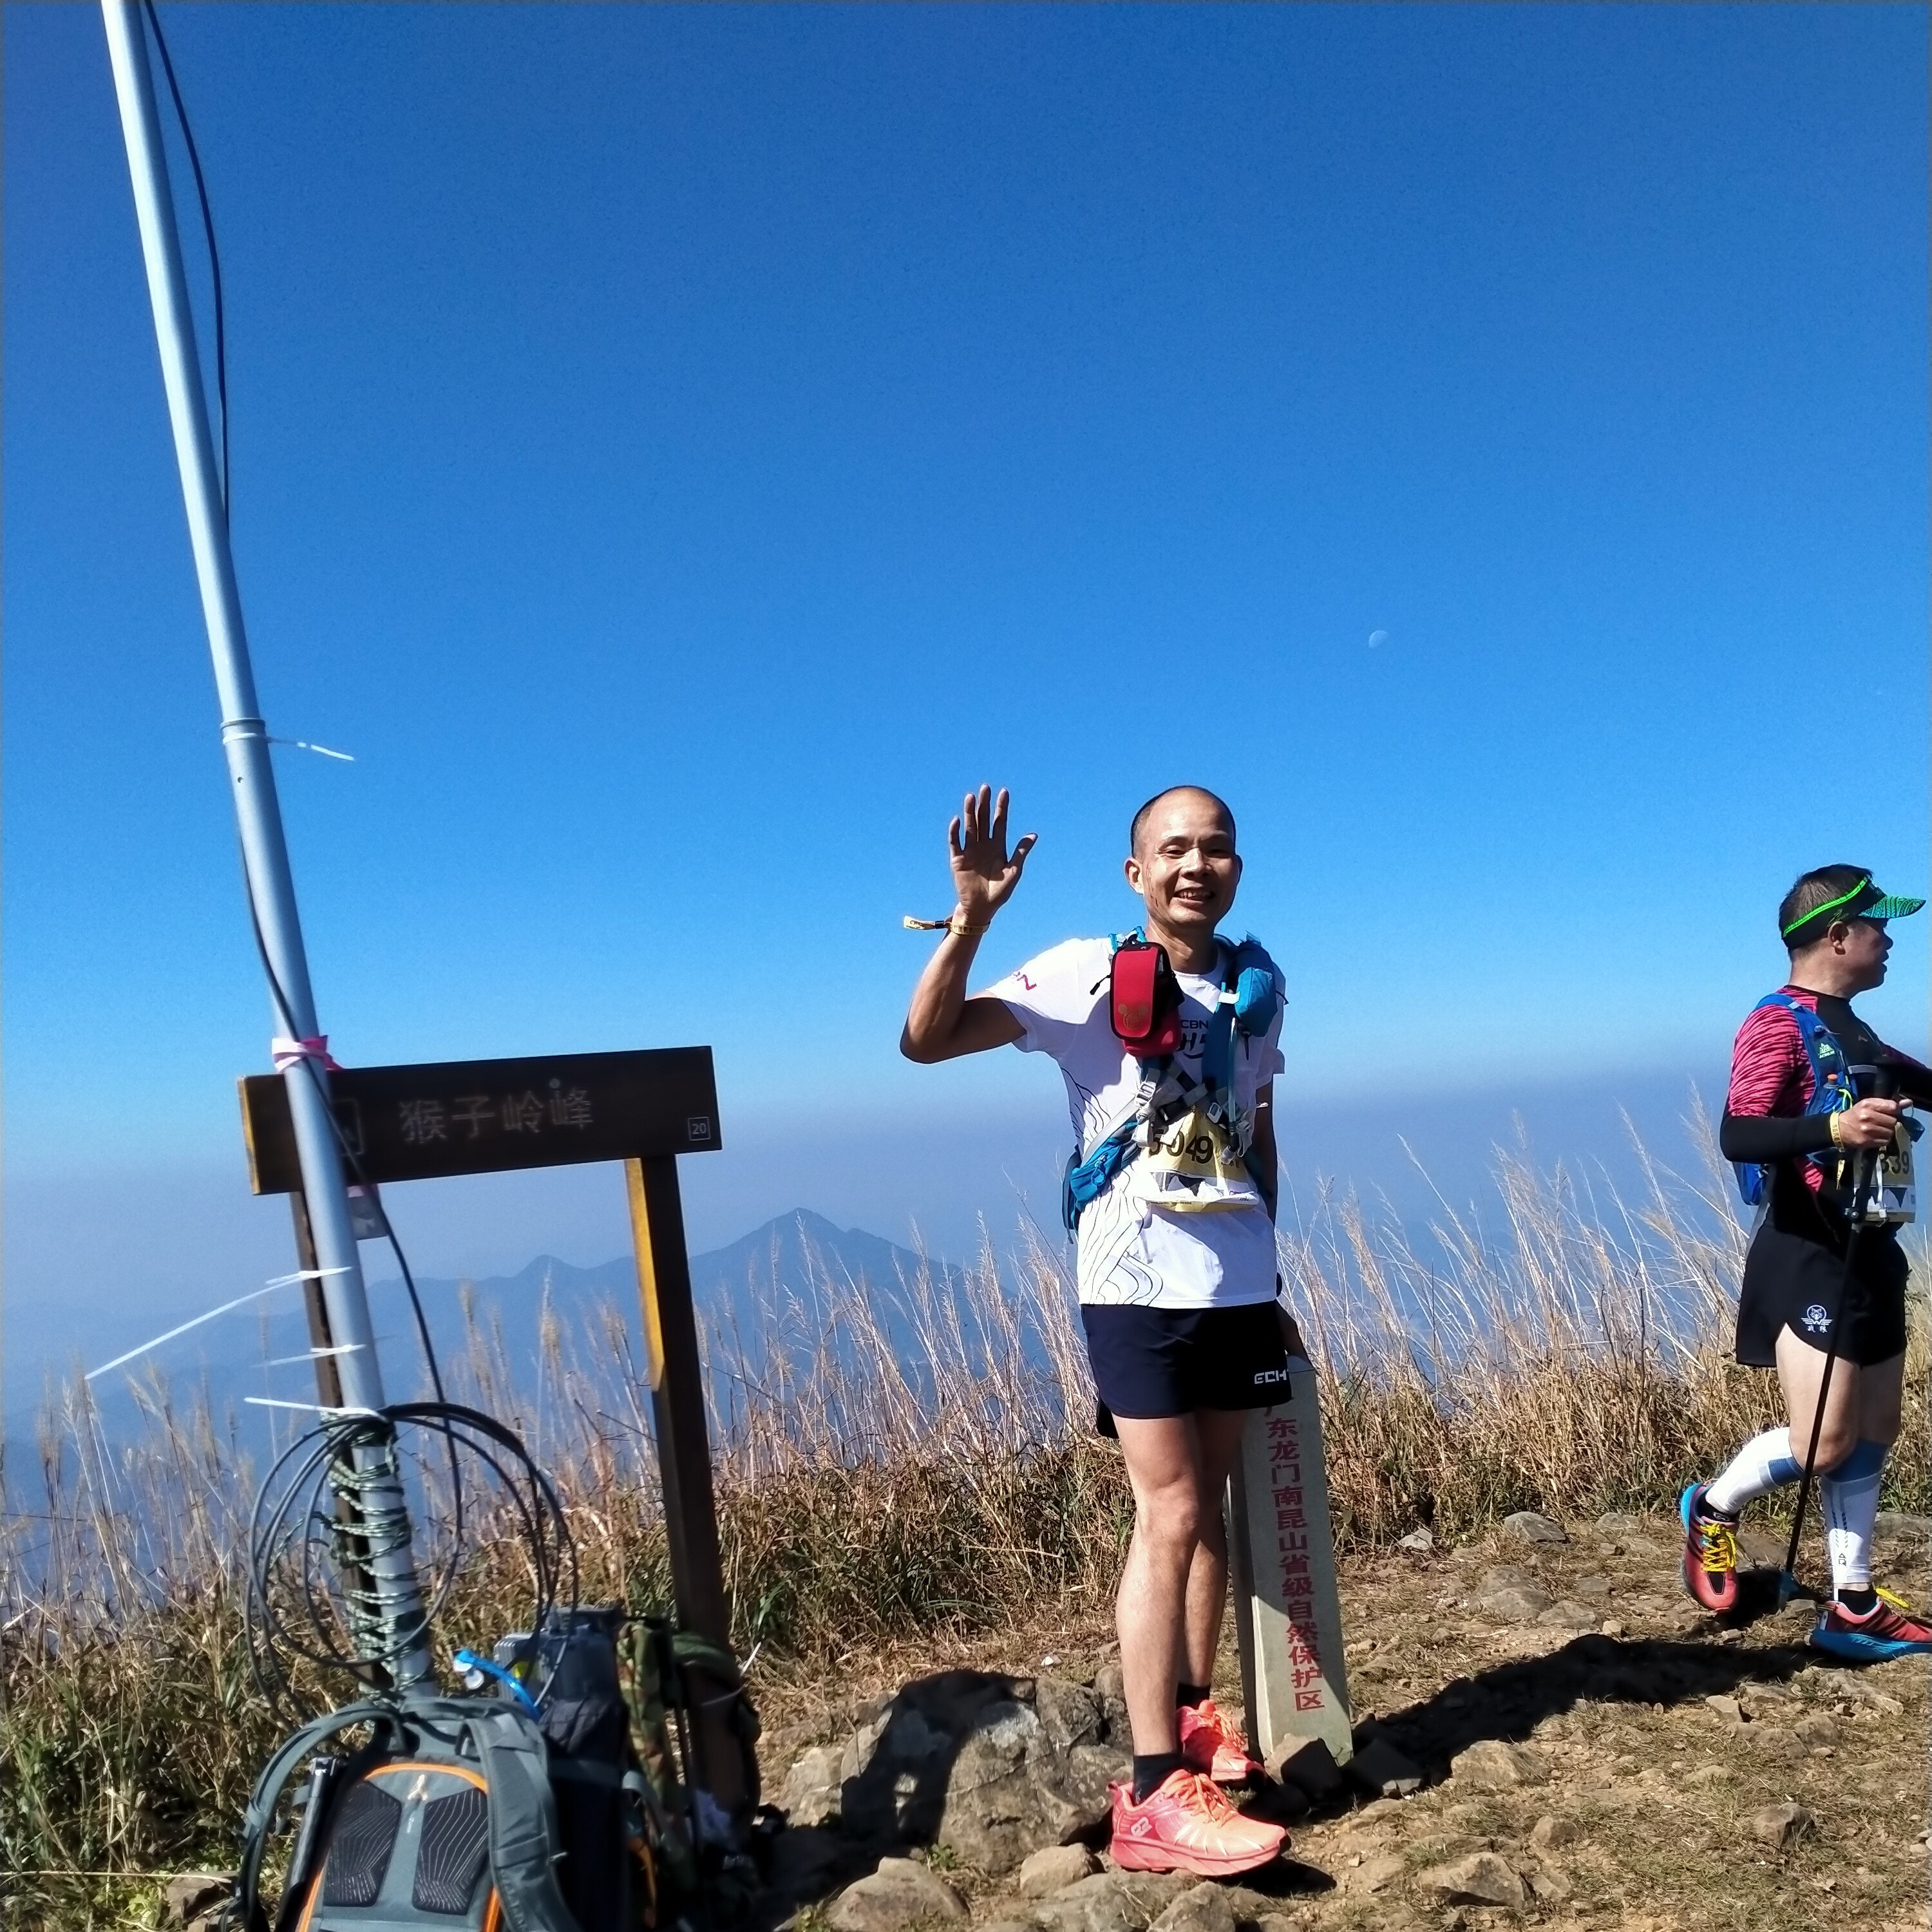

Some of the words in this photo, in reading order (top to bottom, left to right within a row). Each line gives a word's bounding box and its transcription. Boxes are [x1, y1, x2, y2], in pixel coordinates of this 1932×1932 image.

[399, 1089, 594, 1144] 猴子岭峰
[692, 1122, 707, 1135] 20
[1149, 1129, 1213, 1164] 5049
[1264, 1406, 1325, 1712] 东龙门南昆山省级自然保护区
